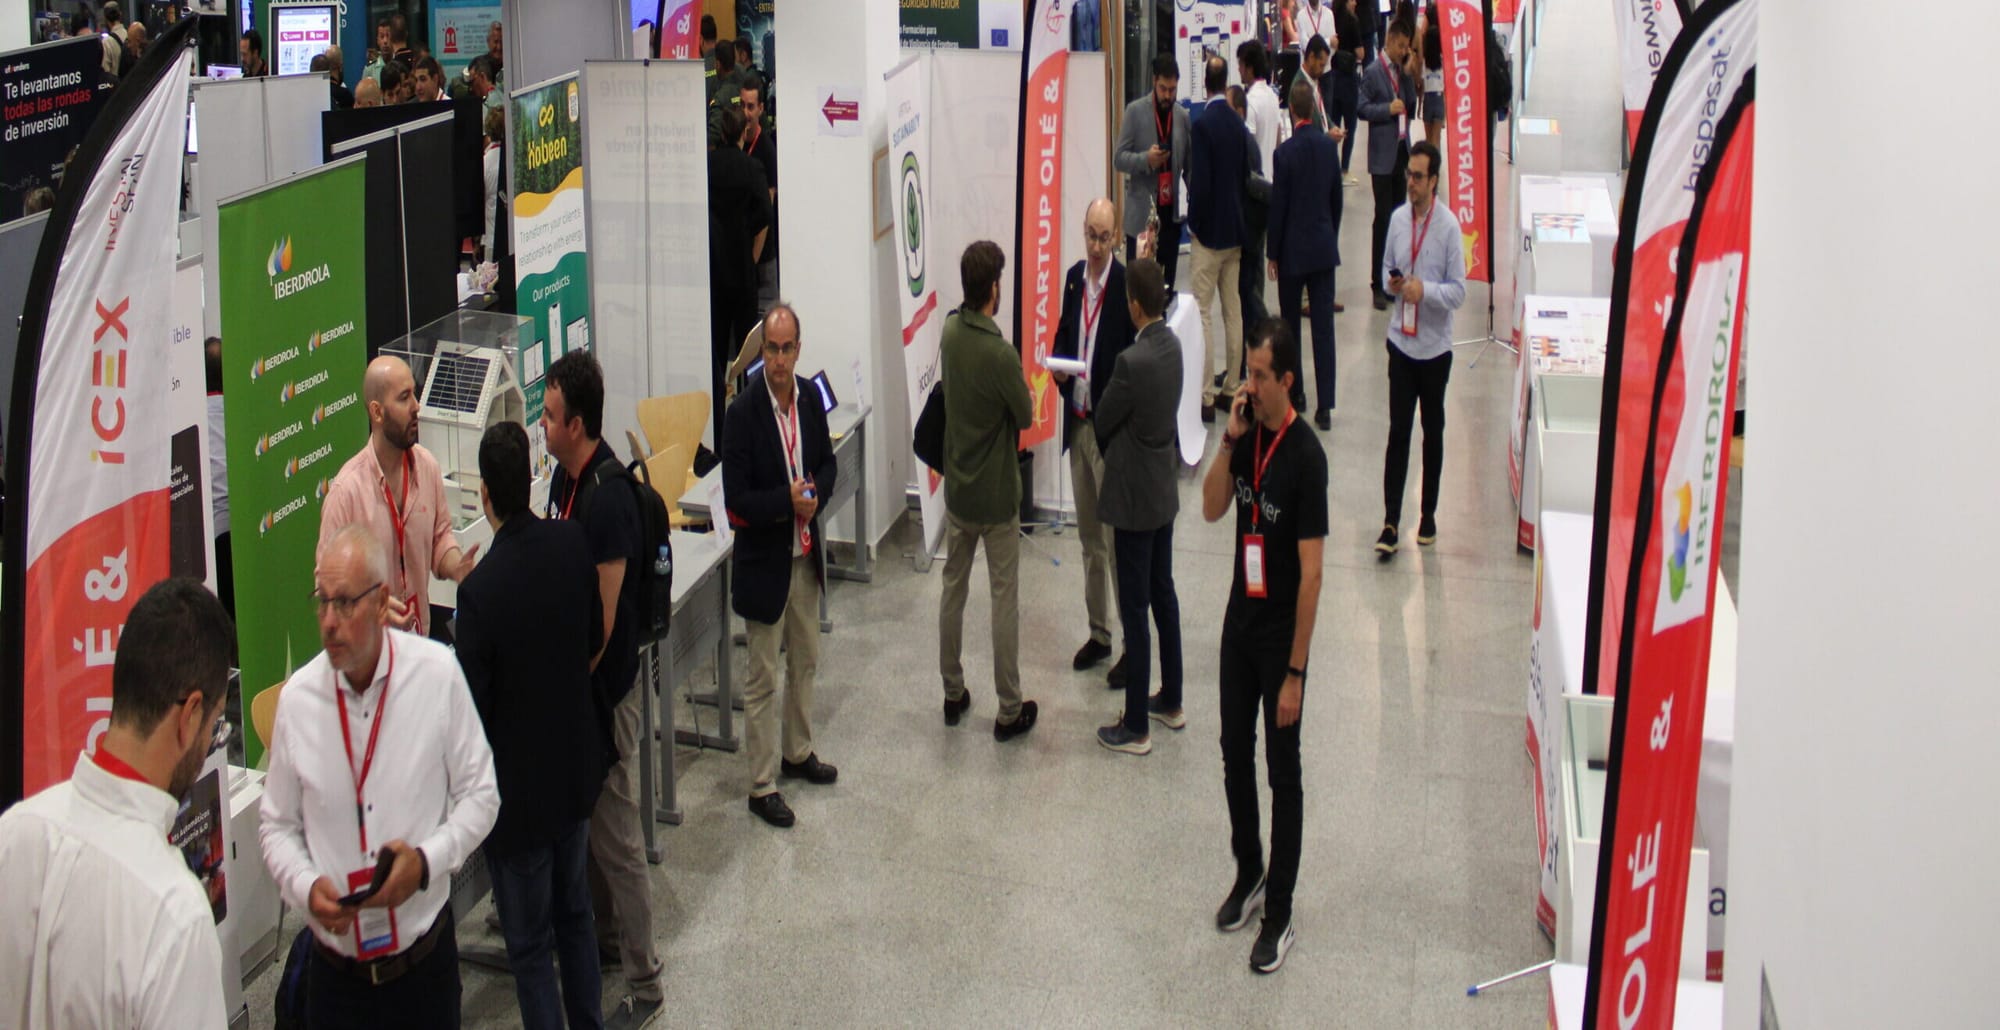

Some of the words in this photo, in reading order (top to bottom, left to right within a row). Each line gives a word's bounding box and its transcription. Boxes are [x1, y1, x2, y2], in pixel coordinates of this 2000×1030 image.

[4, 83, 18, 100] Te
[20, 70, 82, 97] levantamos
[1043, 77, 1060, 104] &
[4, 101, 35, 121] todas
[37, 97, 53, 112] las
[55, 88, 92, 109] rondas
[4, 124, 19, 142] de
[21, 110, 69, 138] inversión
[1038, 113, 1057, 186] OLÉ
[274, 263, 331, 300] IBERDROLA
[532, 288, 544, 303] Our
[544, 275, 570, 300] products
[1034, 194, 1052, 366] STARTUP
[321, 321, 354, 344] IBERDROLA
[264, 346, 300, 372] IBERDROLA
[294, 369, 329, 395] IBERDROLA
[324, 392, 358, 417] IBERDROLA
[268, 420, 303, 448] IBERDROLA
[298, 442, 333, 470] IBERDROLA
[273, 495, 307, 524] IBERDROLA
[84, 546, 128, 602] &
[1617, 820, 1662, 1030] OLÉ
[1650, 692, 1674, 751] &
